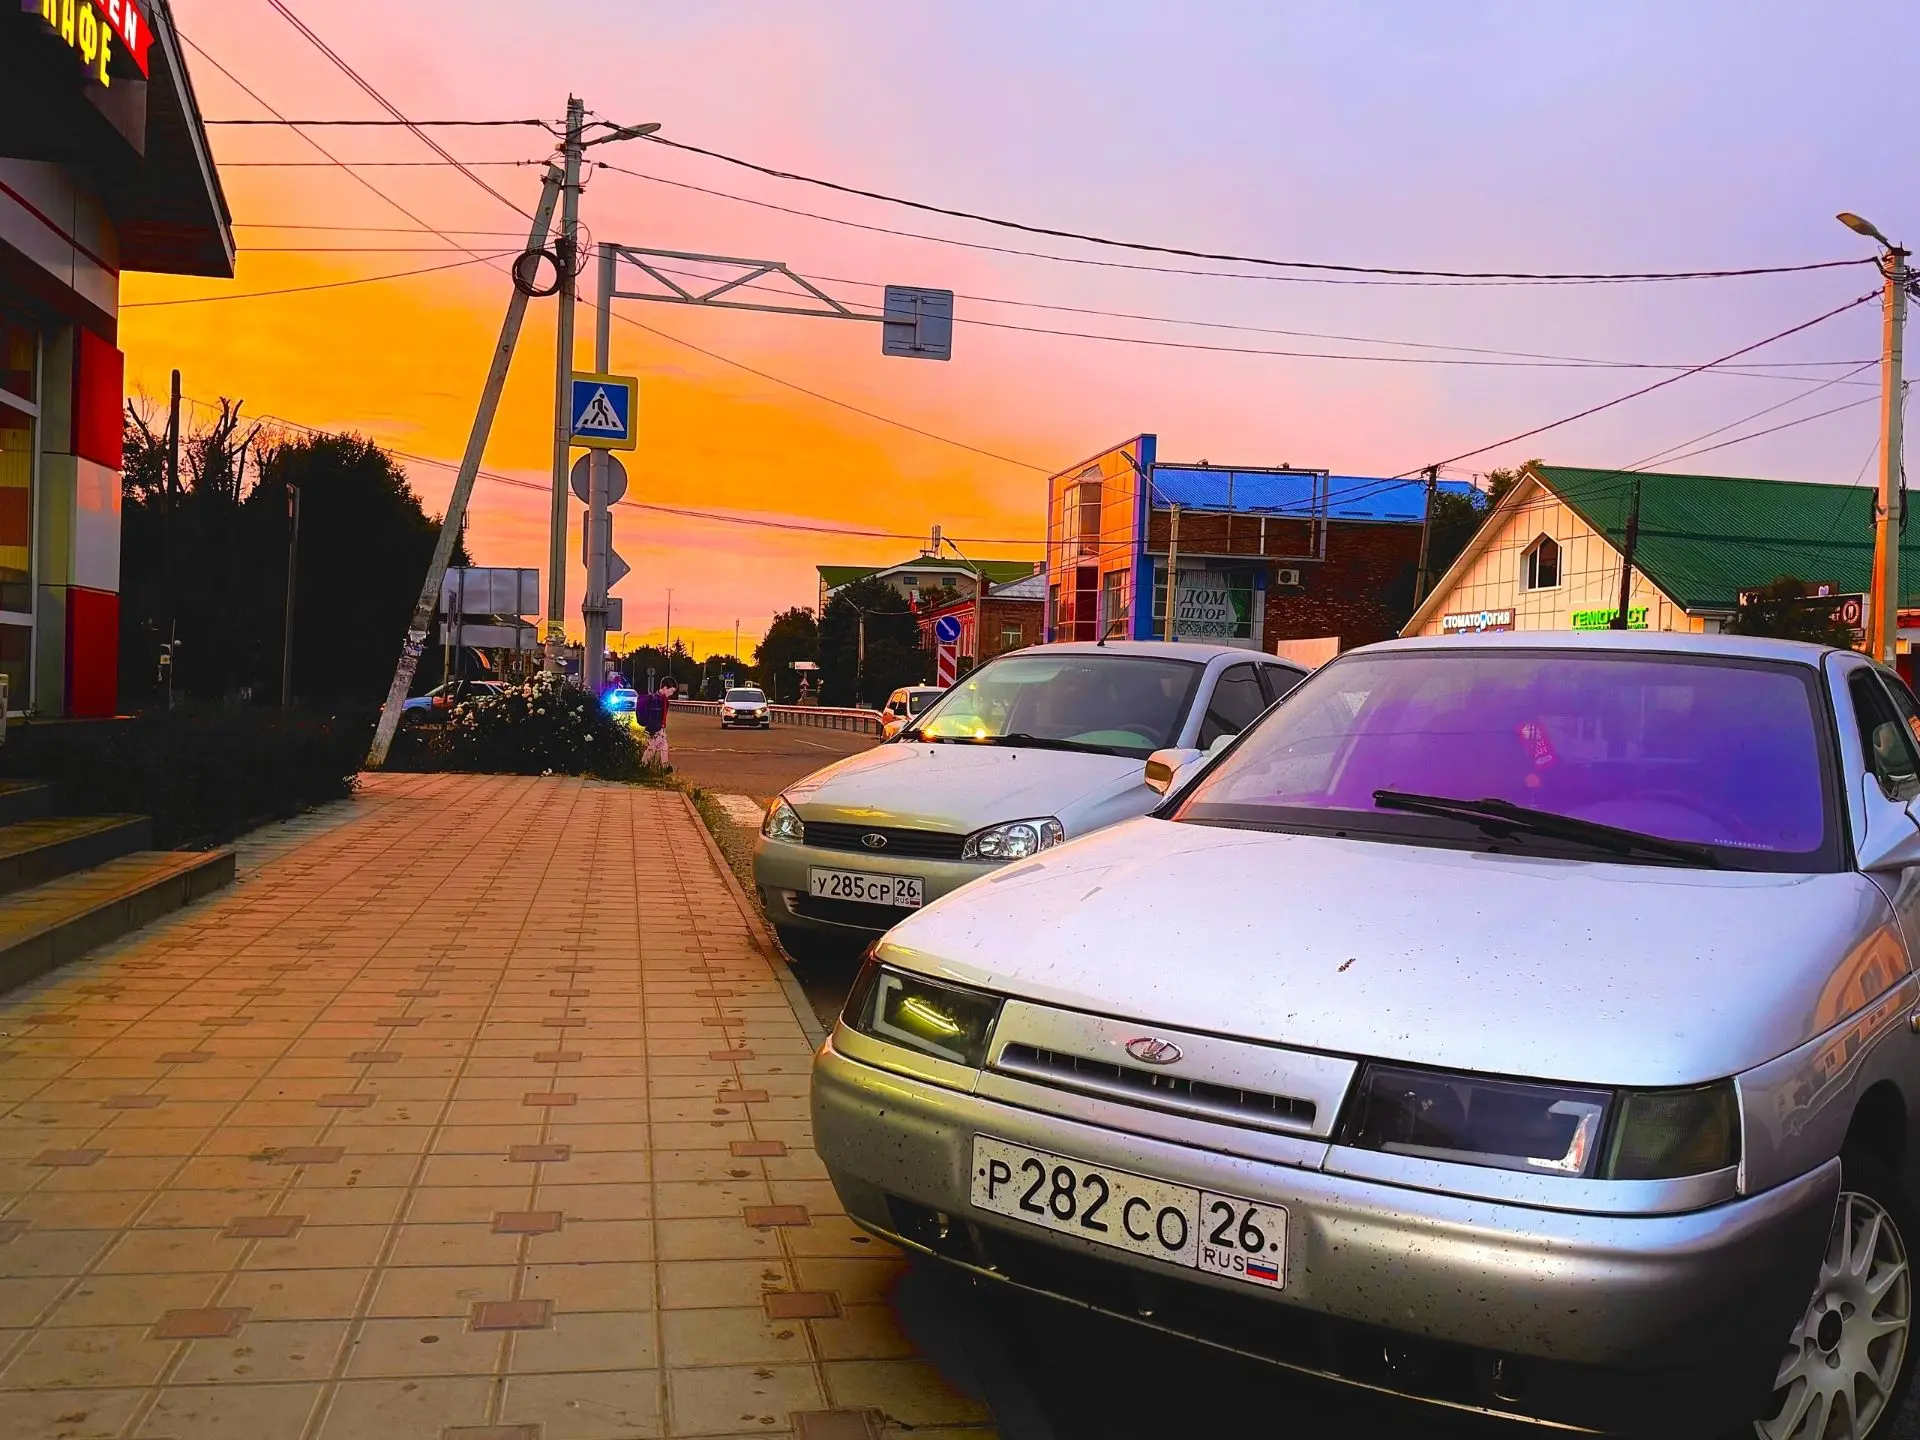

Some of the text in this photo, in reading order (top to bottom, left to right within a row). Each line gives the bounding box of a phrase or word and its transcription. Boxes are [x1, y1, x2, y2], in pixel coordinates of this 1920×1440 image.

[100, 0, 137, 51] EN
[1180, 589, 1228, 607] ДОМ
[1180, 607, 1226, 620] ШТОР
[1572, 607, 1648, 626] ГЕМОТСТ
[896, 880, 916, 897] 26
[895, 896, 909, 905] RUS
[1209, 1200, 1265, 1253] 26
[1203, 1249, 1244, 1272] RUS
